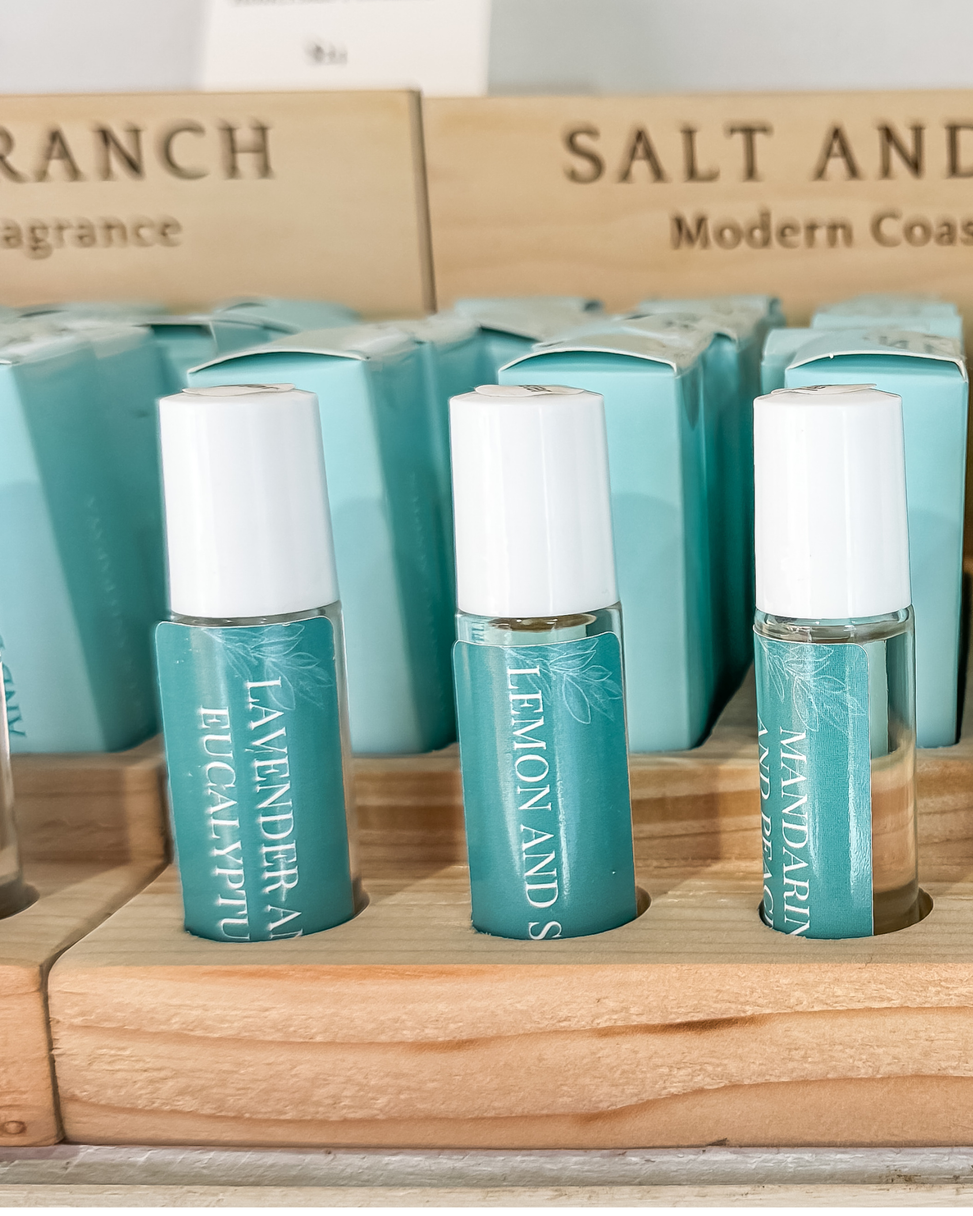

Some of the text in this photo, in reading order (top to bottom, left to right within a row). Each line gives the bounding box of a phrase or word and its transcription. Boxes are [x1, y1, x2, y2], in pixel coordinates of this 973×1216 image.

[562, 118, 774, 184] SALT
[668, 204, 855, 250] Modern
[197, 706, 251, 940] EUCALYPTU
[244, 676, 300, 894] LAVENDER
[506, 665, 562, 940] LEMON AND S
